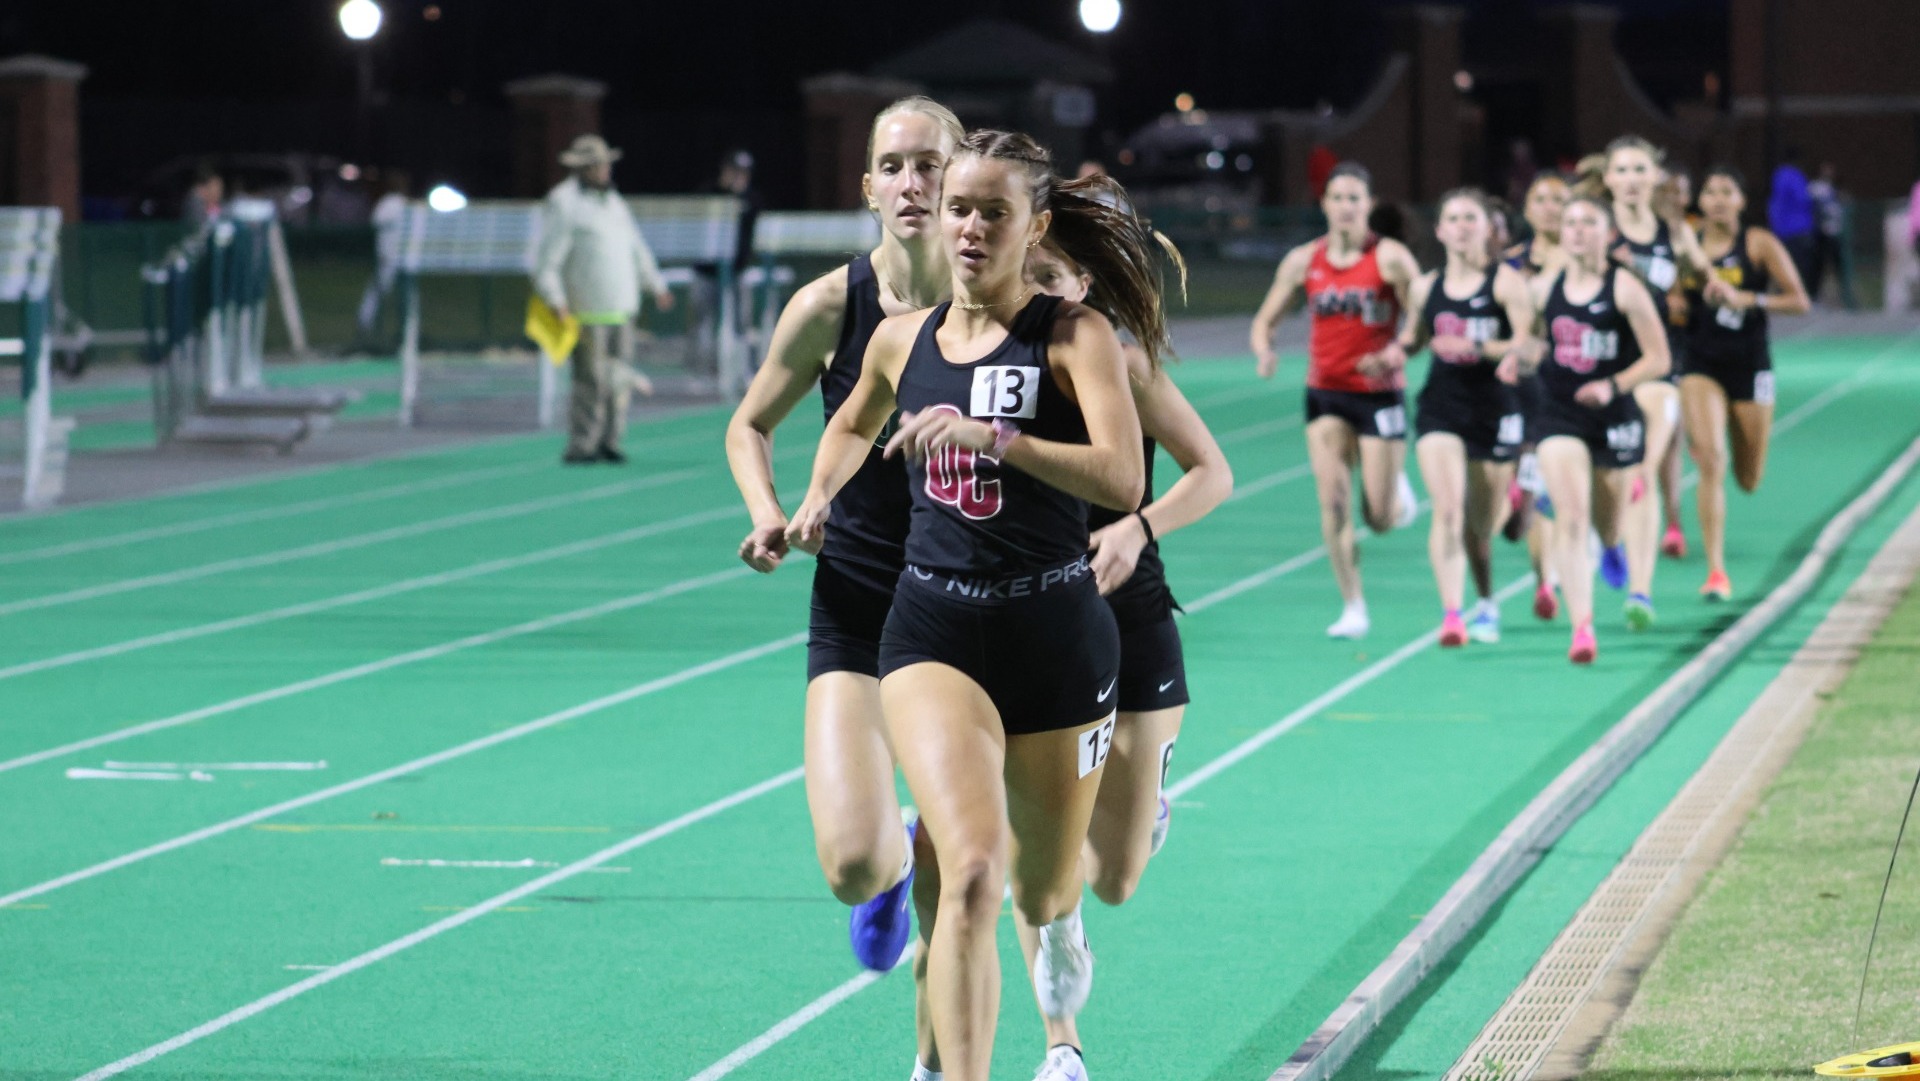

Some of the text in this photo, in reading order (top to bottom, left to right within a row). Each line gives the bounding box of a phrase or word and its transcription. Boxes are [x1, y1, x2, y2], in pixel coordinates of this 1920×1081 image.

[983, 368, 1026, 415] 13
[945, 574, 1033, 599] NIKE
[1088, 720, 1112, 769] 13
